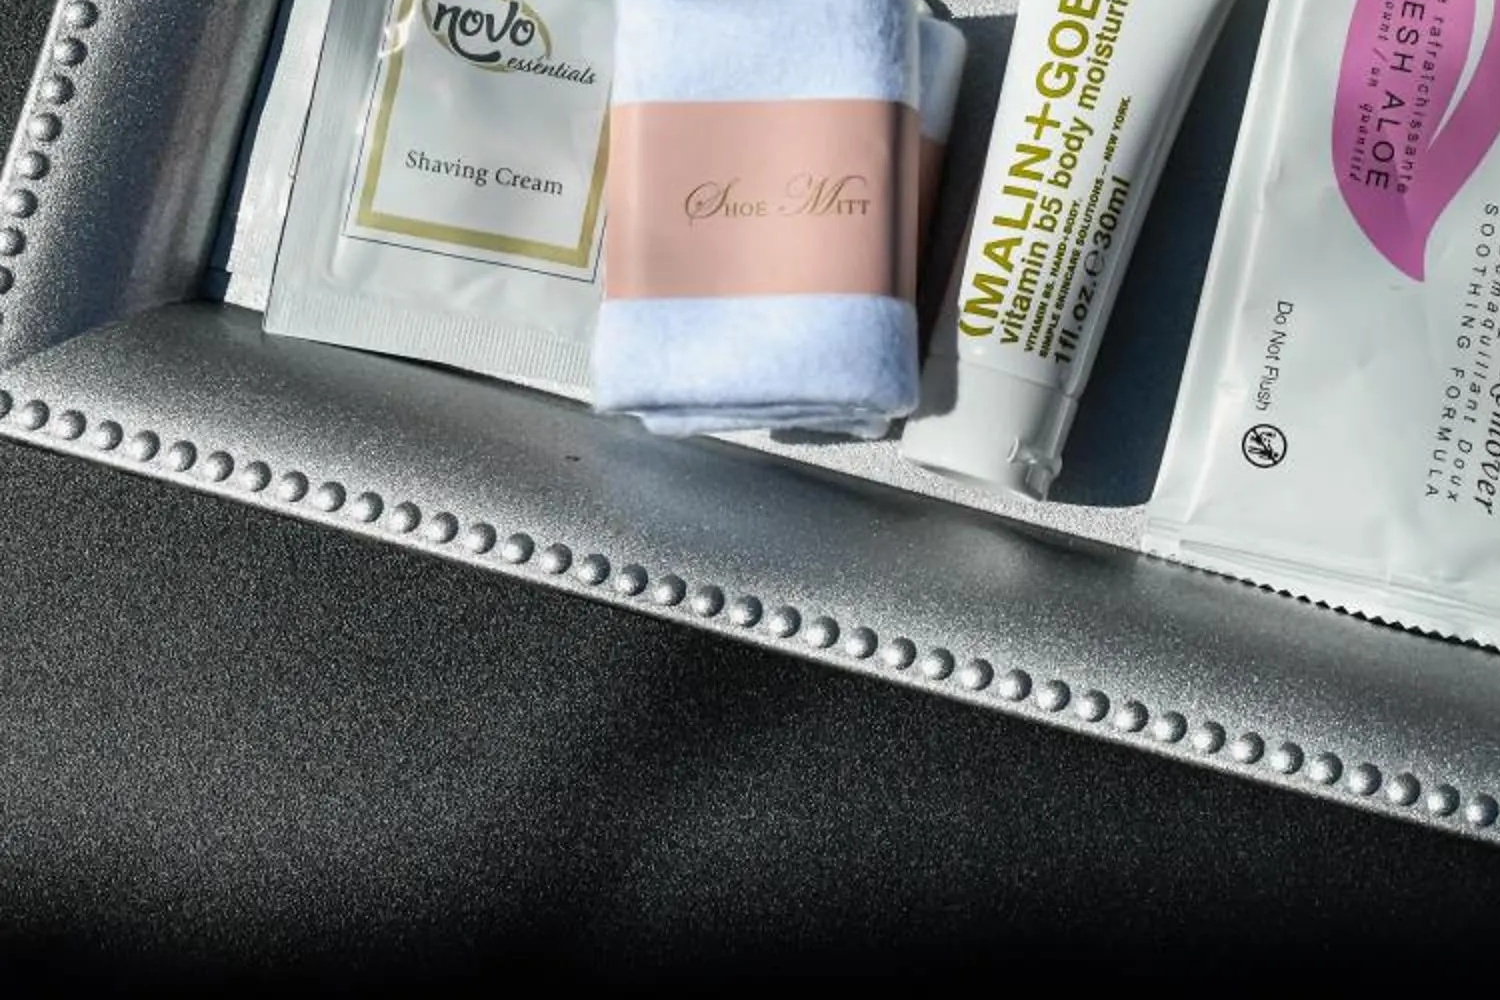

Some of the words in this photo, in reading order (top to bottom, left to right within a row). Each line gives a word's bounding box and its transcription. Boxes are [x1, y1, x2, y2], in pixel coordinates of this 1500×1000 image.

[433, 1, 535, 62] novo
[1047, 117, 1094, 189] body
[1365, 91, 1405, 190] ALOE
[405, 150, 488, 187] Shaving
[495, 167, 563, 195] Cream
[1033, 196, 1063, 233] b5
[1039, 313, 1060, 358] SIMPLE
[1055, 250, 1081, 310] SKINCARE
[1076, 178, 1104, 246] SOLUTIONS
[1104, 134, 1118, 162] NEW
[1456, 204, 1499, 349] SOOTHING
[1000, 242, 1049, 343] vitamin
[1273, 300, 1294, 326] Do
[1024, 302, 1048, 351] VITAMIN
[1266, 330, 1288, 361] Not
[1256, 365, 1280, 411] Flush
[1426, 368, 1464, 496] FORMULA
[1447, 439, 1472, 502] Doux
